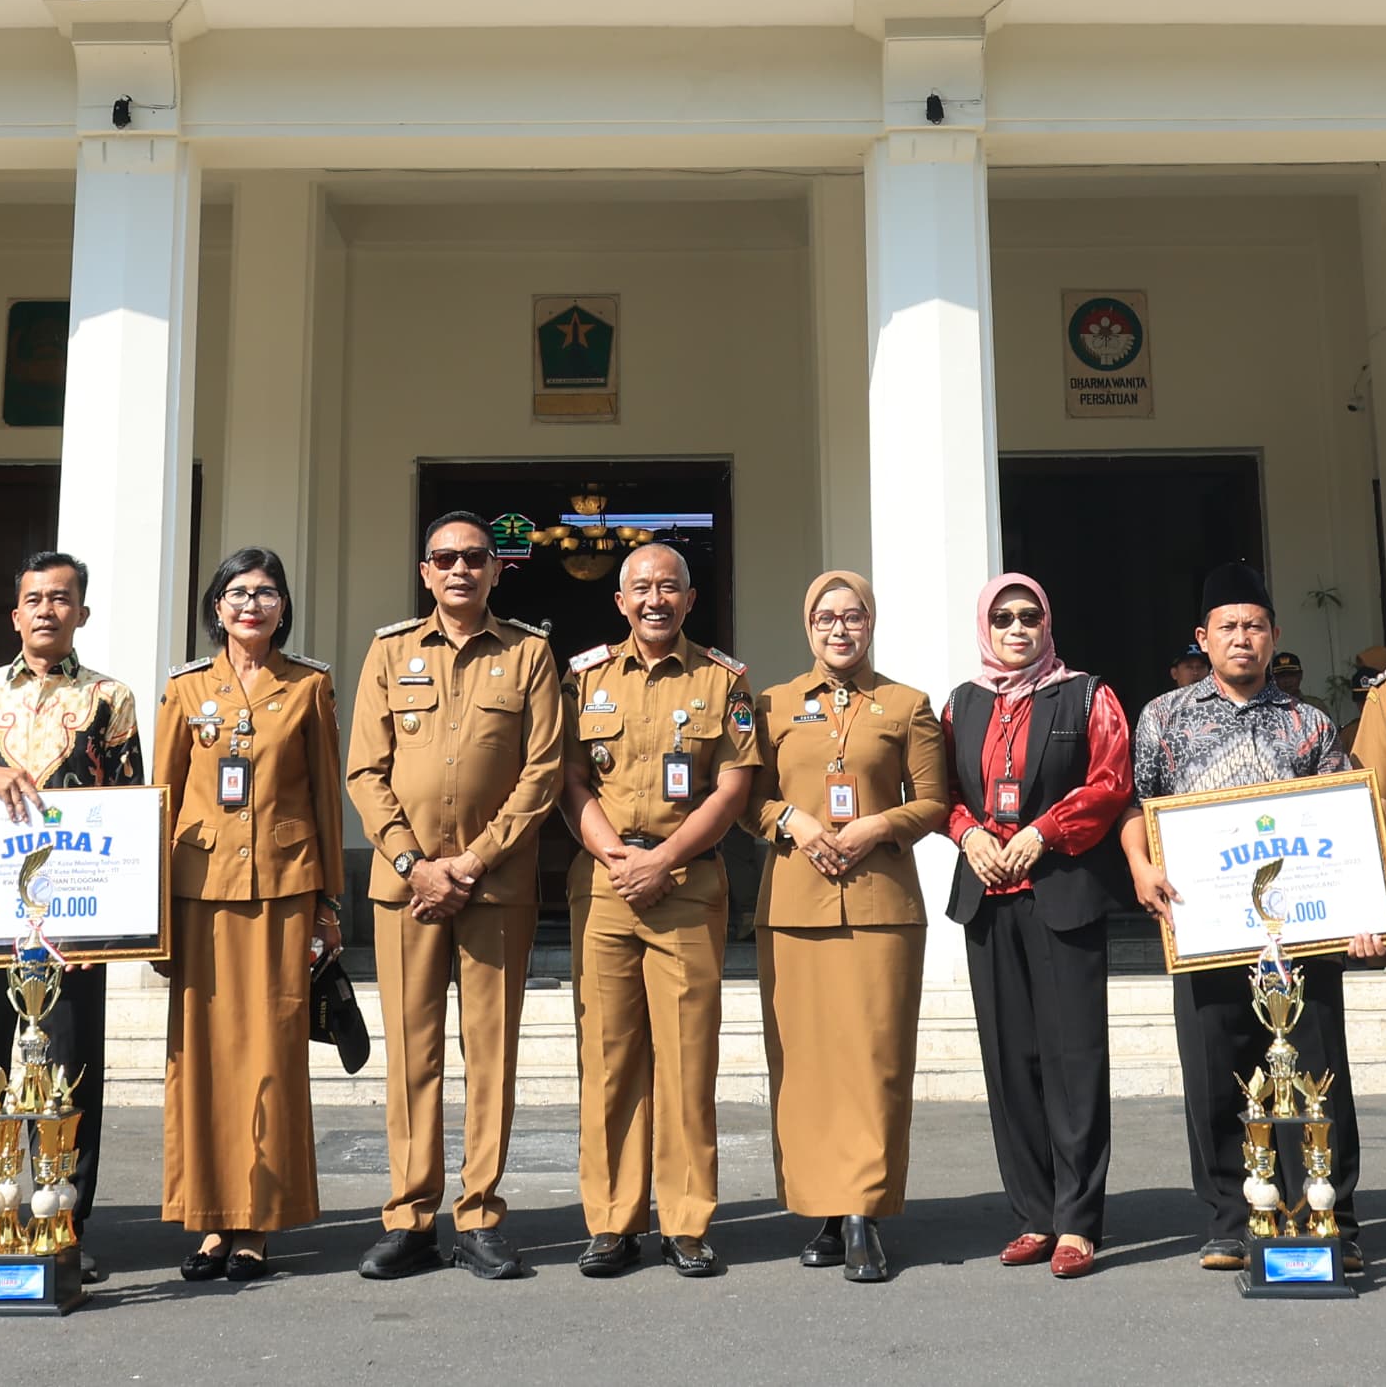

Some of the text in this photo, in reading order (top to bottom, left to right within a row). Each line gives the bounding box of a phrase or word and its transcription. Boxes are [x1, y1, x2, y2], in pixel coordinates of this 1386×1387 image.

[1070, 377, 1148, 390] DHARMA WANITA
[1080, 393, 1138, 405] PERSATUAN
[1, 831, 114, 860] JUARA 1
[1220, 836, 1334, 872] JUARA 2
[16, 896, 98, 919] 3.0.000
[1244, 900, 1327, 929] 3..000
